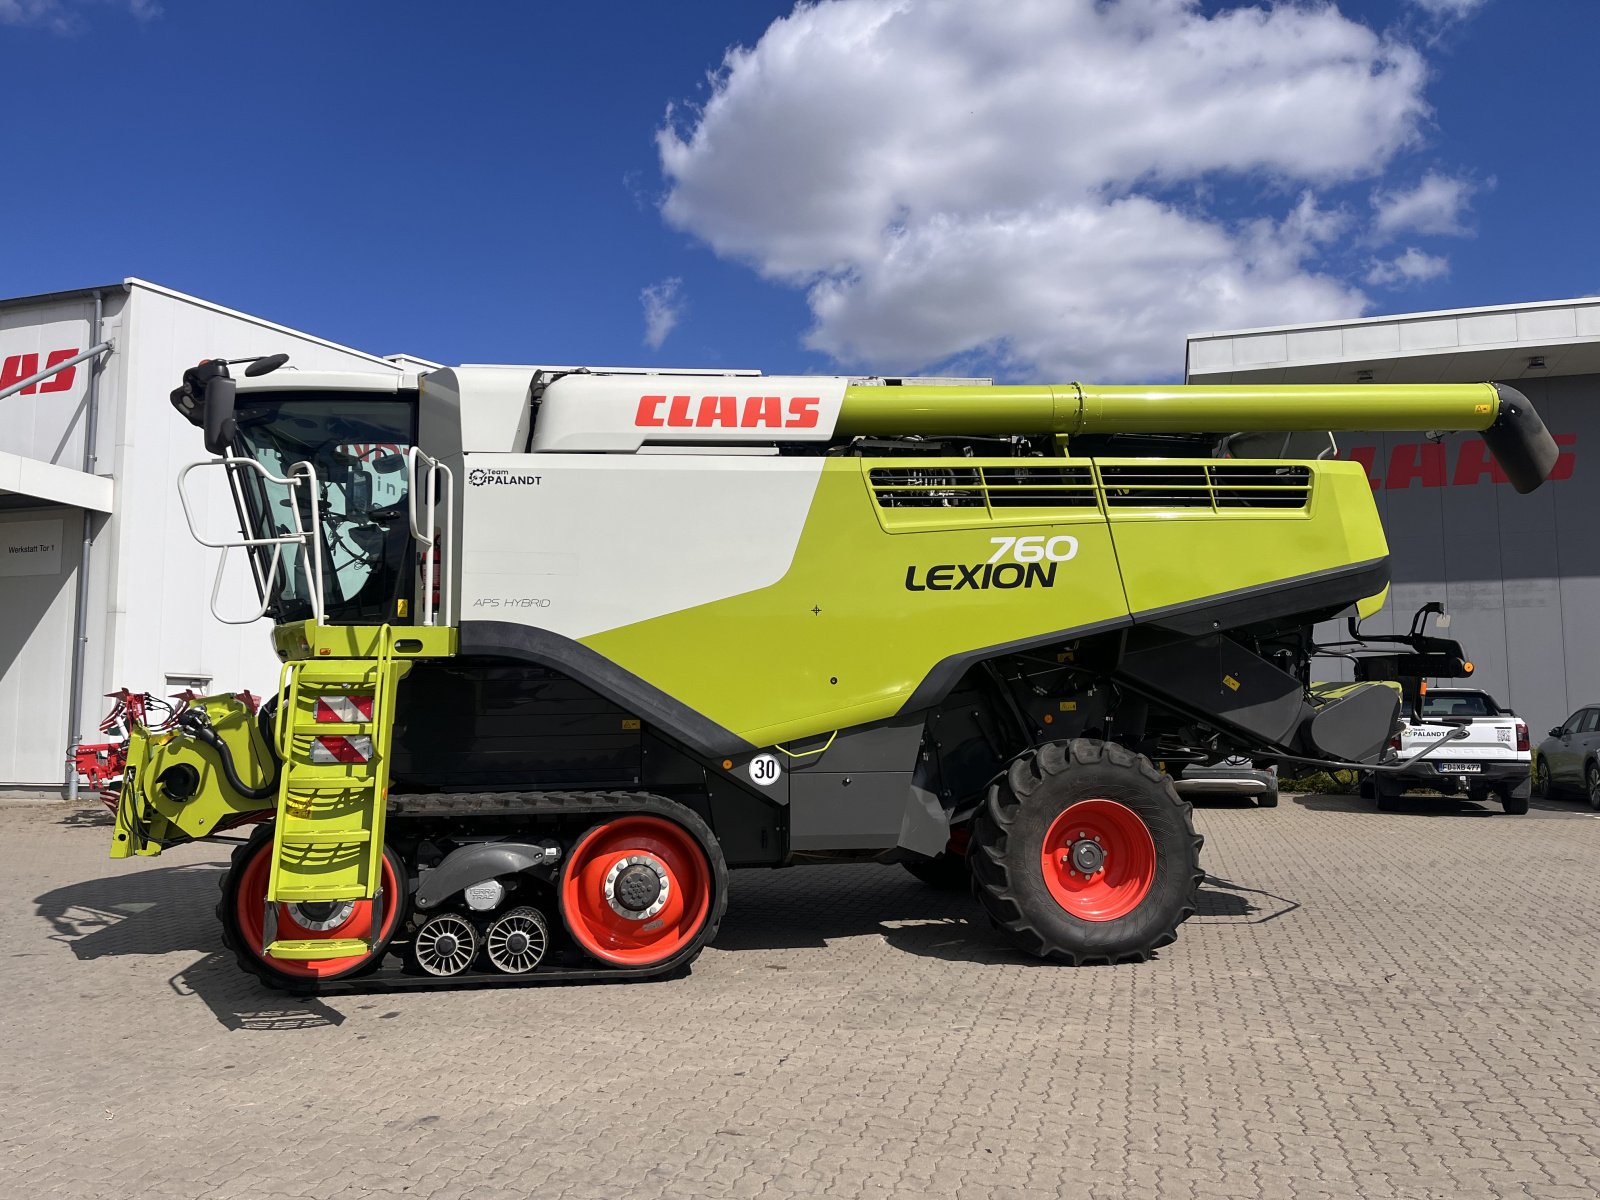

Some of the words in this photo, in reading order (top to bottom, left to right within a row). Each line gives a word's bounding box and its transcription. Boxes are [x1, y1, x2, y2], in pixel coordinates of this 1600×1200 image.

[634, 395, 820, 429] CLAAS
[487, 475, 542, 486] PALANDT
[8, 545, 38, 554] Werkstatt
[39, 544, 50, 552] Tor
[987, 535, 1079, 563] 760
[905, 562, 1058, 592] LEXION
[473, 598, 500, 607] APS
[504, 598, 551, 608] HYBRID
[755, 760, 775, 779] 30
[1466, 763, 1480, 771] 477
